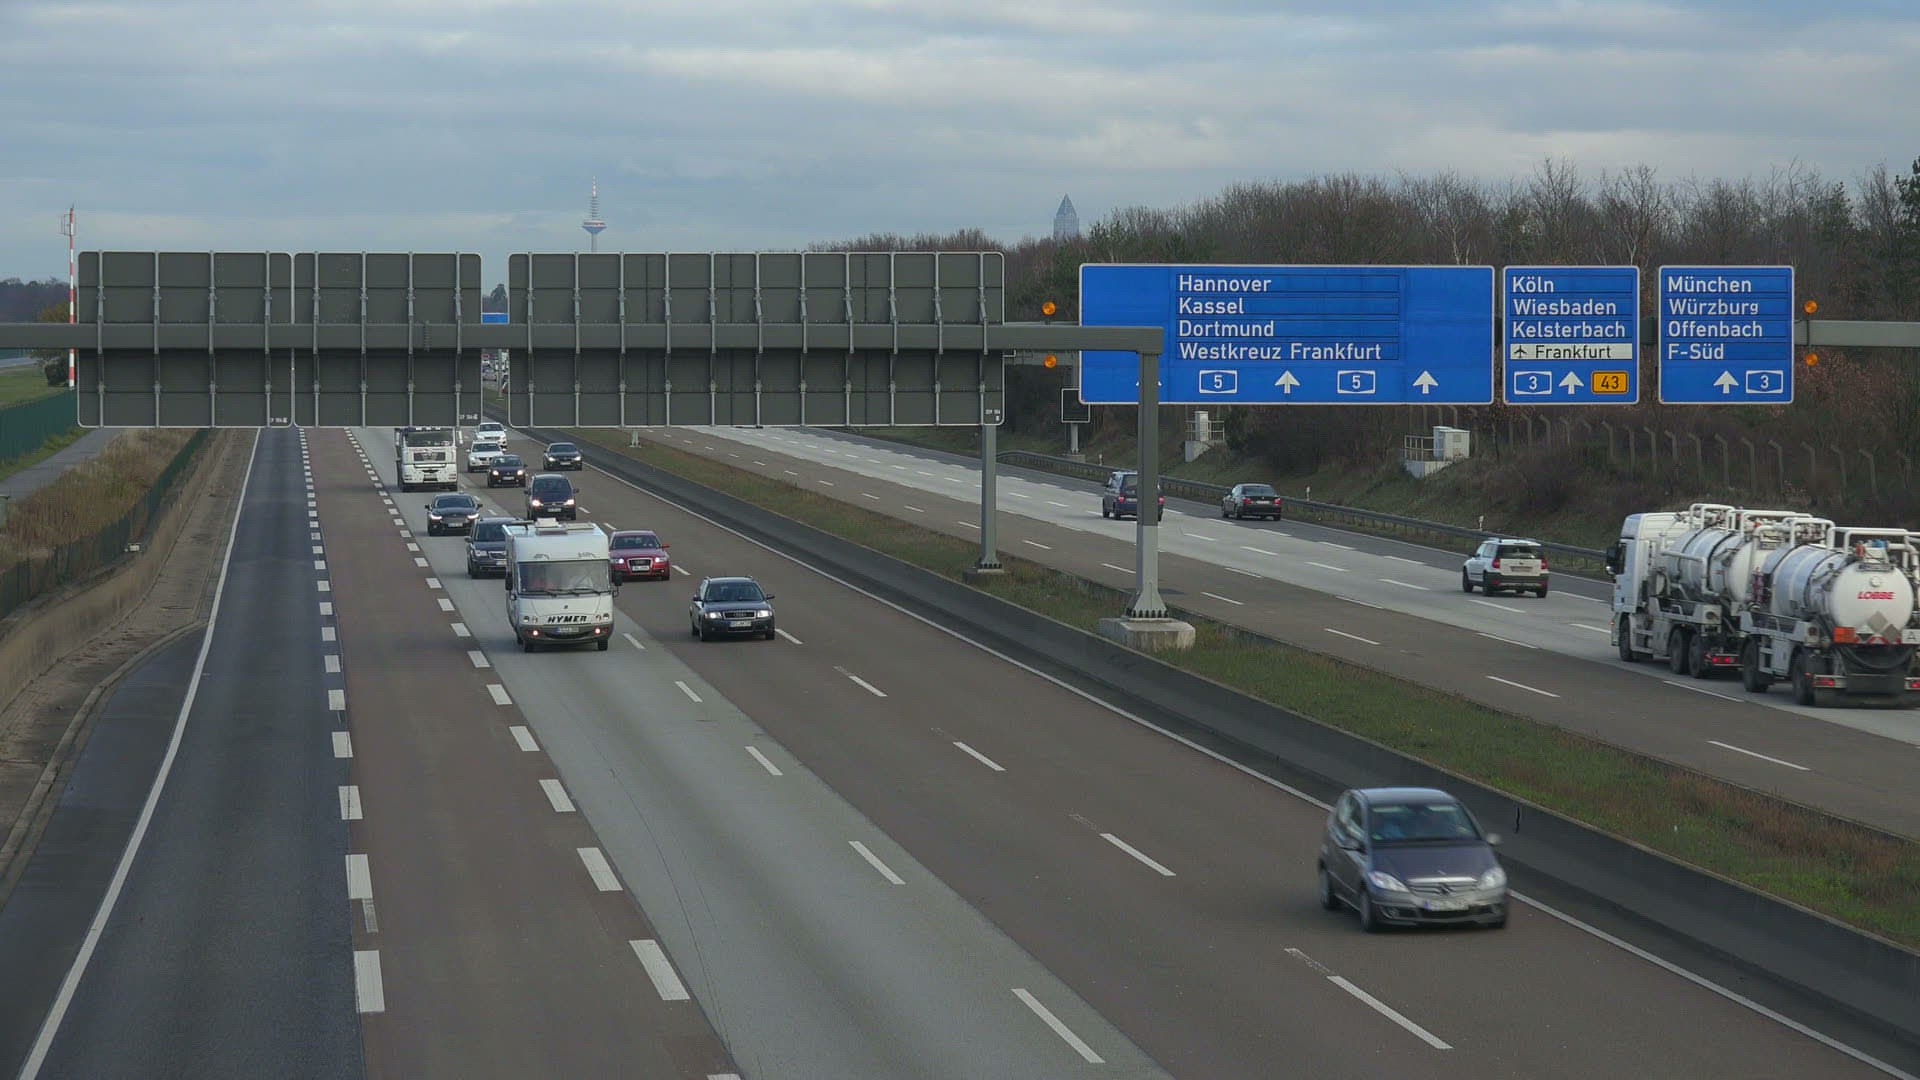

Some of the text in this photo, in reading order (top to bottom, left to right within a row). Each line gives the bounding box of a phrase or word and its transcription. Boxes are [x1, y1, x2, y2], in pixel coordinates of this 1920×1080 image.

[1180, 275, 1271, 291] Hannover
[1513, 276, 1553, 292] Köln
[1669, 276, 1751, 292] München
[1180, 297, 1244, 313] Kassel
[1514, 299, 1616, 315] Wiesbaden
[1669, 299, 1758, 315] Würzburg
[1180, 320, 1274, 336] Dortmund
[1513, 321, 1625, 337] Kelsterbach
[1669, 321, 1762, 336] Offenbach
[1180, 343, 1380, 359] Westkreuz Frankfurt
[1536, 345, 1610, 358] Frankfurt
[1669, 343, 1723, 359] F-Süd
[1214, 375, 1223, 389] 5
[1352, 375, 1361, 389] 5
[1528, 376, 1538, 390] 3
[1600, 376, 1620, 390] 43
[1760, 376, 1769, 390] 3
[547, 615, 588, 624] HYMER
